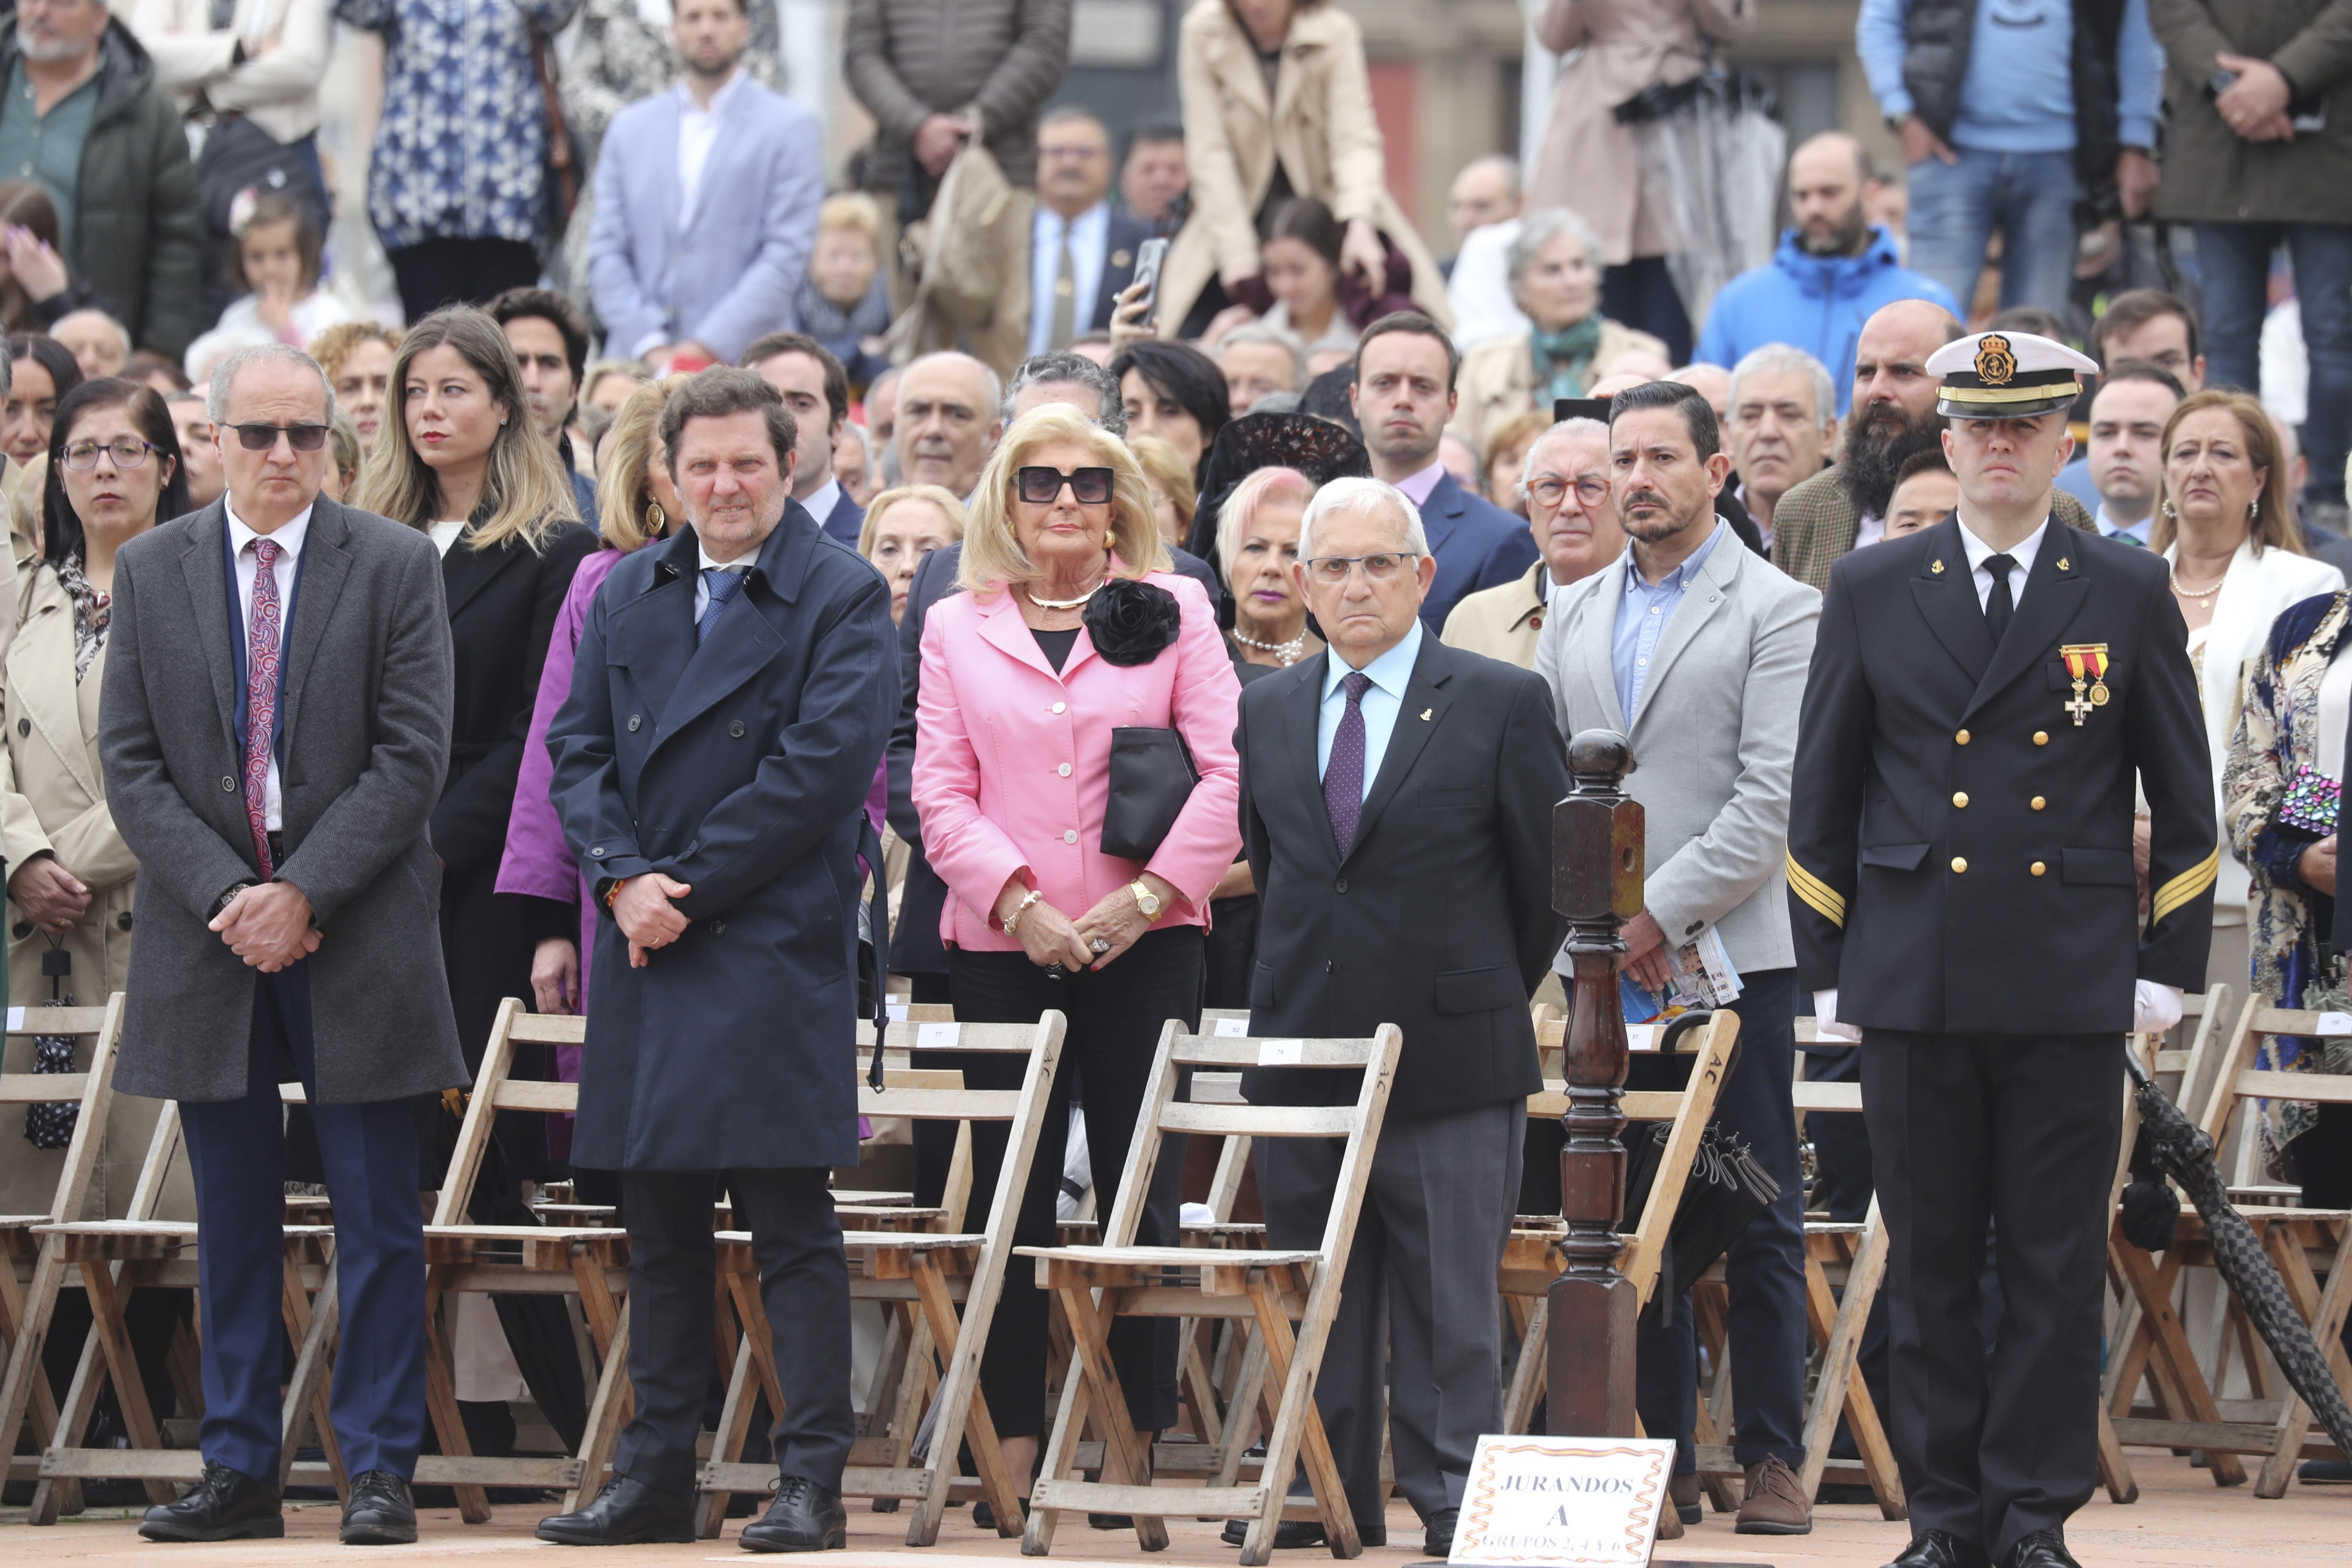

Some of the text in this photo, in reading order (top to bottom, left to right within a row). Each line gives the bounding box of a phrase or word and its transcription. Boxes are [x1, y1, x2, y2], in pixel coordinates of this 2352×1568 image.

[1705, 1052, 1722, 1084] AC
[1501, 1475, 1633, 1493] JURANDOS
[1547, 1504, 1568, 1526] A
[1482, 1534, 1620, 1553] GRUPOS 2, 4 Y 6
